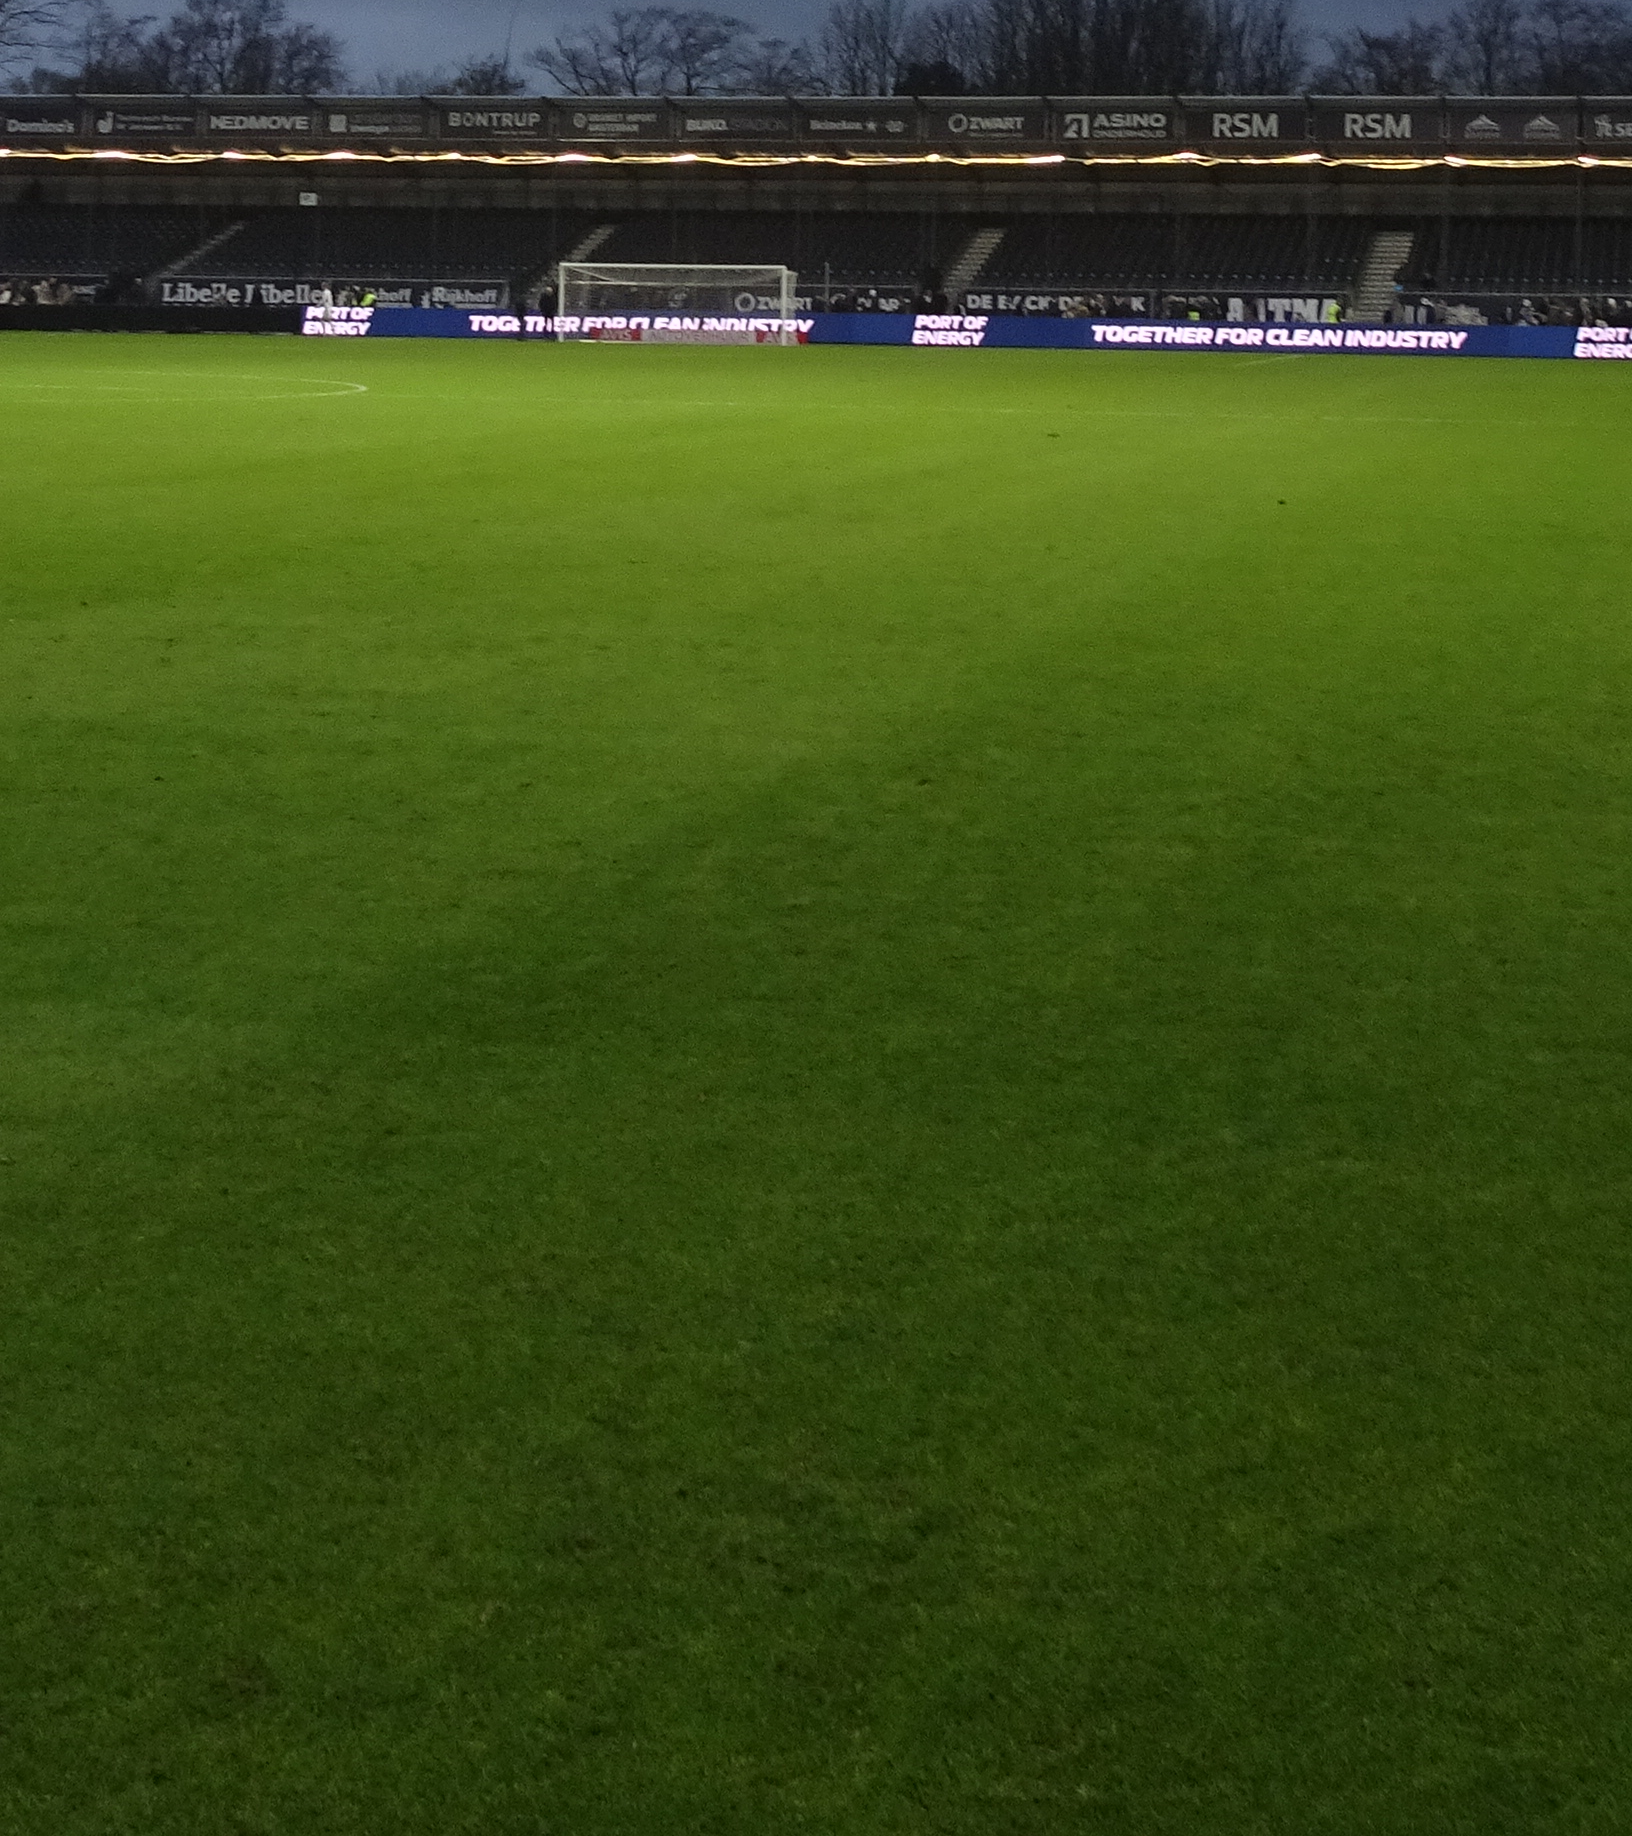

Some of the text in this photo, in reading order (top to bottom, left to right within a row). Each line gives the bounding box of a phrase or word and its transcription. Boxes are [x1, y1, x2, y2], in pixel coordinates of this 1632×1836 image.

[448, 112, 541, 127] BONTRUP
[969, 117, 1025, 130] ZWART
[1093, 113, 1167, 127] ASINO
[1212, 113, 1279, 138] RSM
[1344, 113, 1412, 139] RSM
[350, 306, 374, 321] OF
[914, 315, 989, 331] PORT OF
[912, 330, 985, 346] ENERGY
[1091, 325, 1468, 350] TOGETHER FOR CLEAN INDUSTRY
[1576, 327, 1627, 343] PORT
